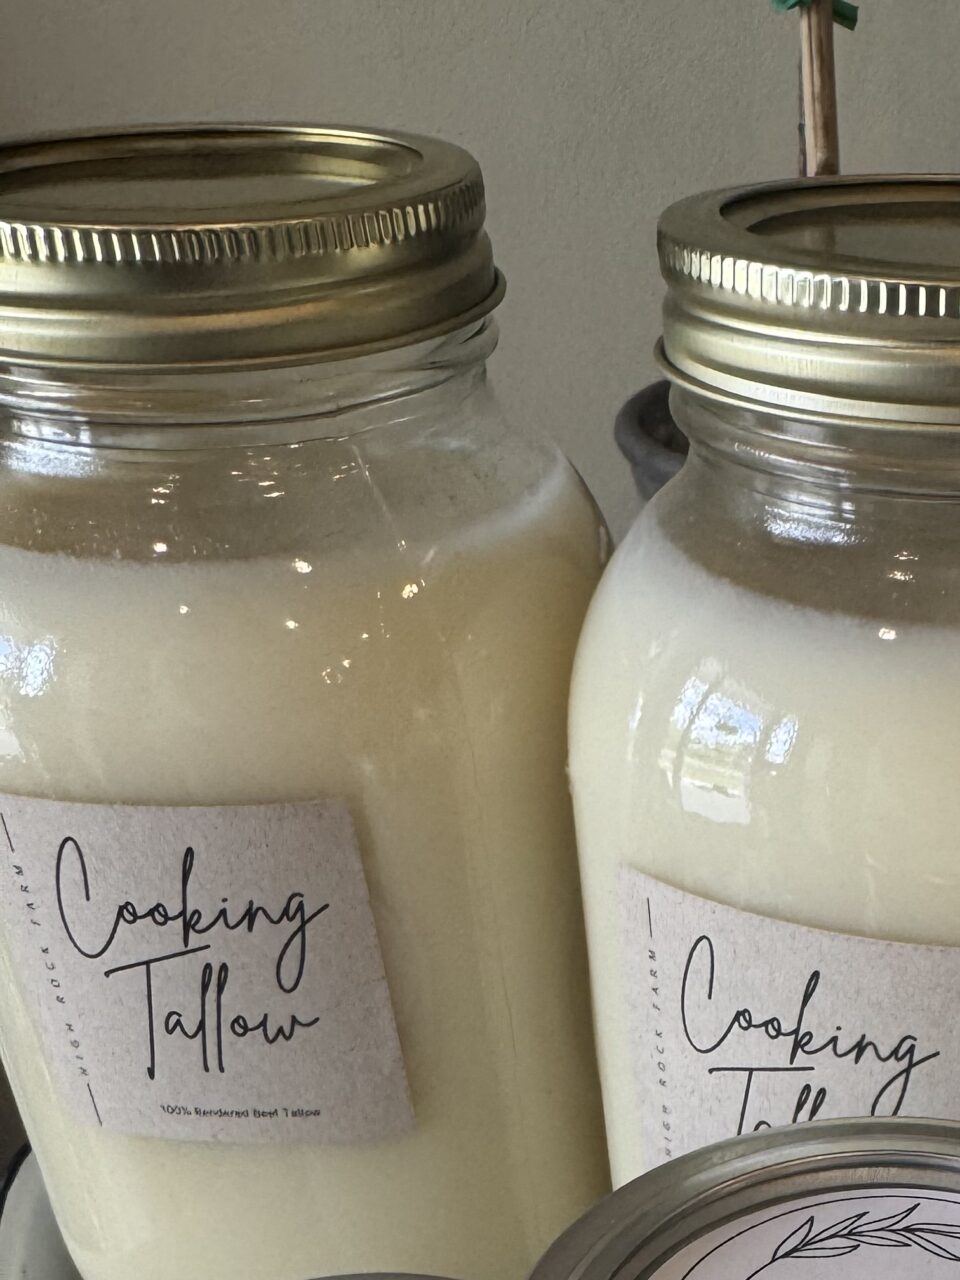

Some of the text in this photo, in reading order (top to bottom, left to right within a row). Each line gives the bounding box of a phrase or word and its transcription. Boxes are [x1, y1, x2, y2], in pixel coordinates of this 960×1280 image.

[56, 836, 330, 993] Cooking
[648, 950, 661, 1012] FARM
[104, 944, 320, 1080] Tallow
[681, 935, 940, 1116] Cooking
